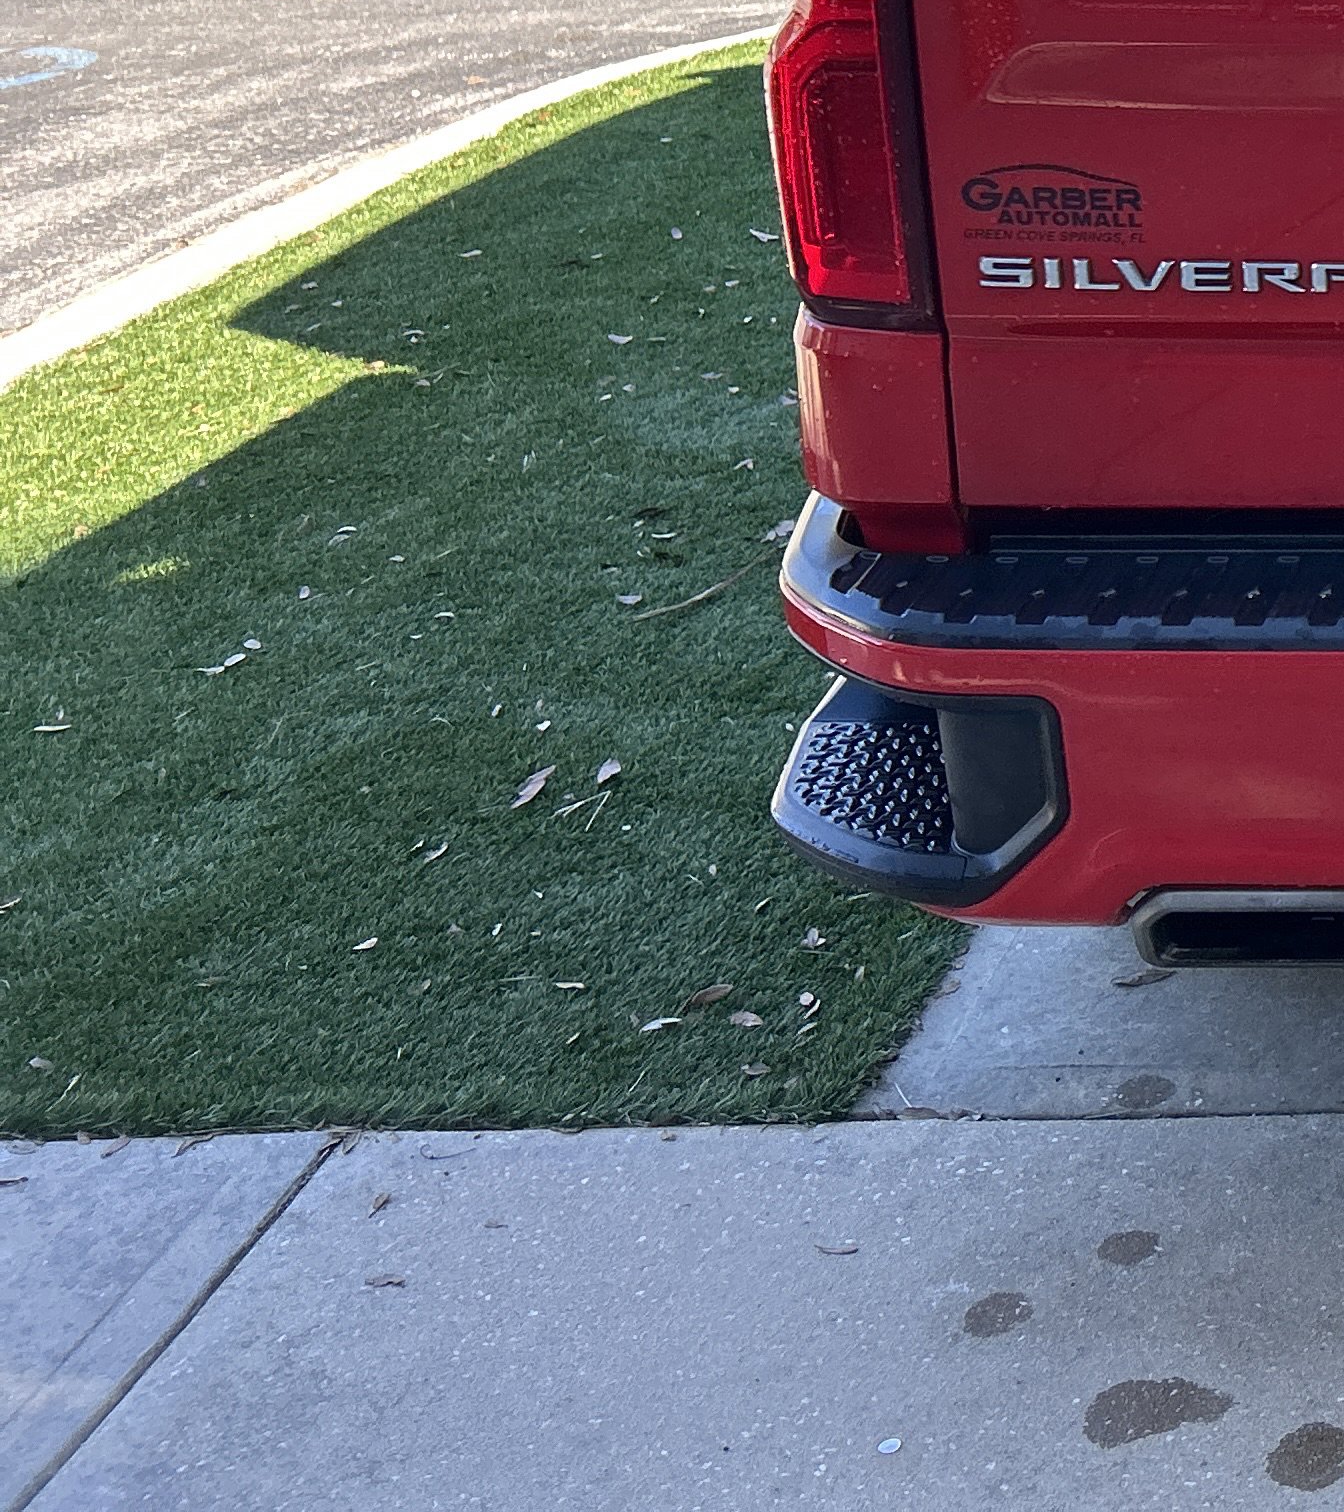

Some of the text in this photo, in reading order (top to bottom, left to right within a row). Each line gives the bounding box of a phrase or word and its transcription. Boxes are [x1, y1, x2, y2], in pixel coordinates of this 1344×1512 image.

[961, 177, 1143, 212] GARBER
[997, 209, 1143, 228] AUTOMALL
[963, 228, 1013, 240] GREEN
[1016, 230, 1057, 242] COVE
[1130, 233, 1146, 244] FL
